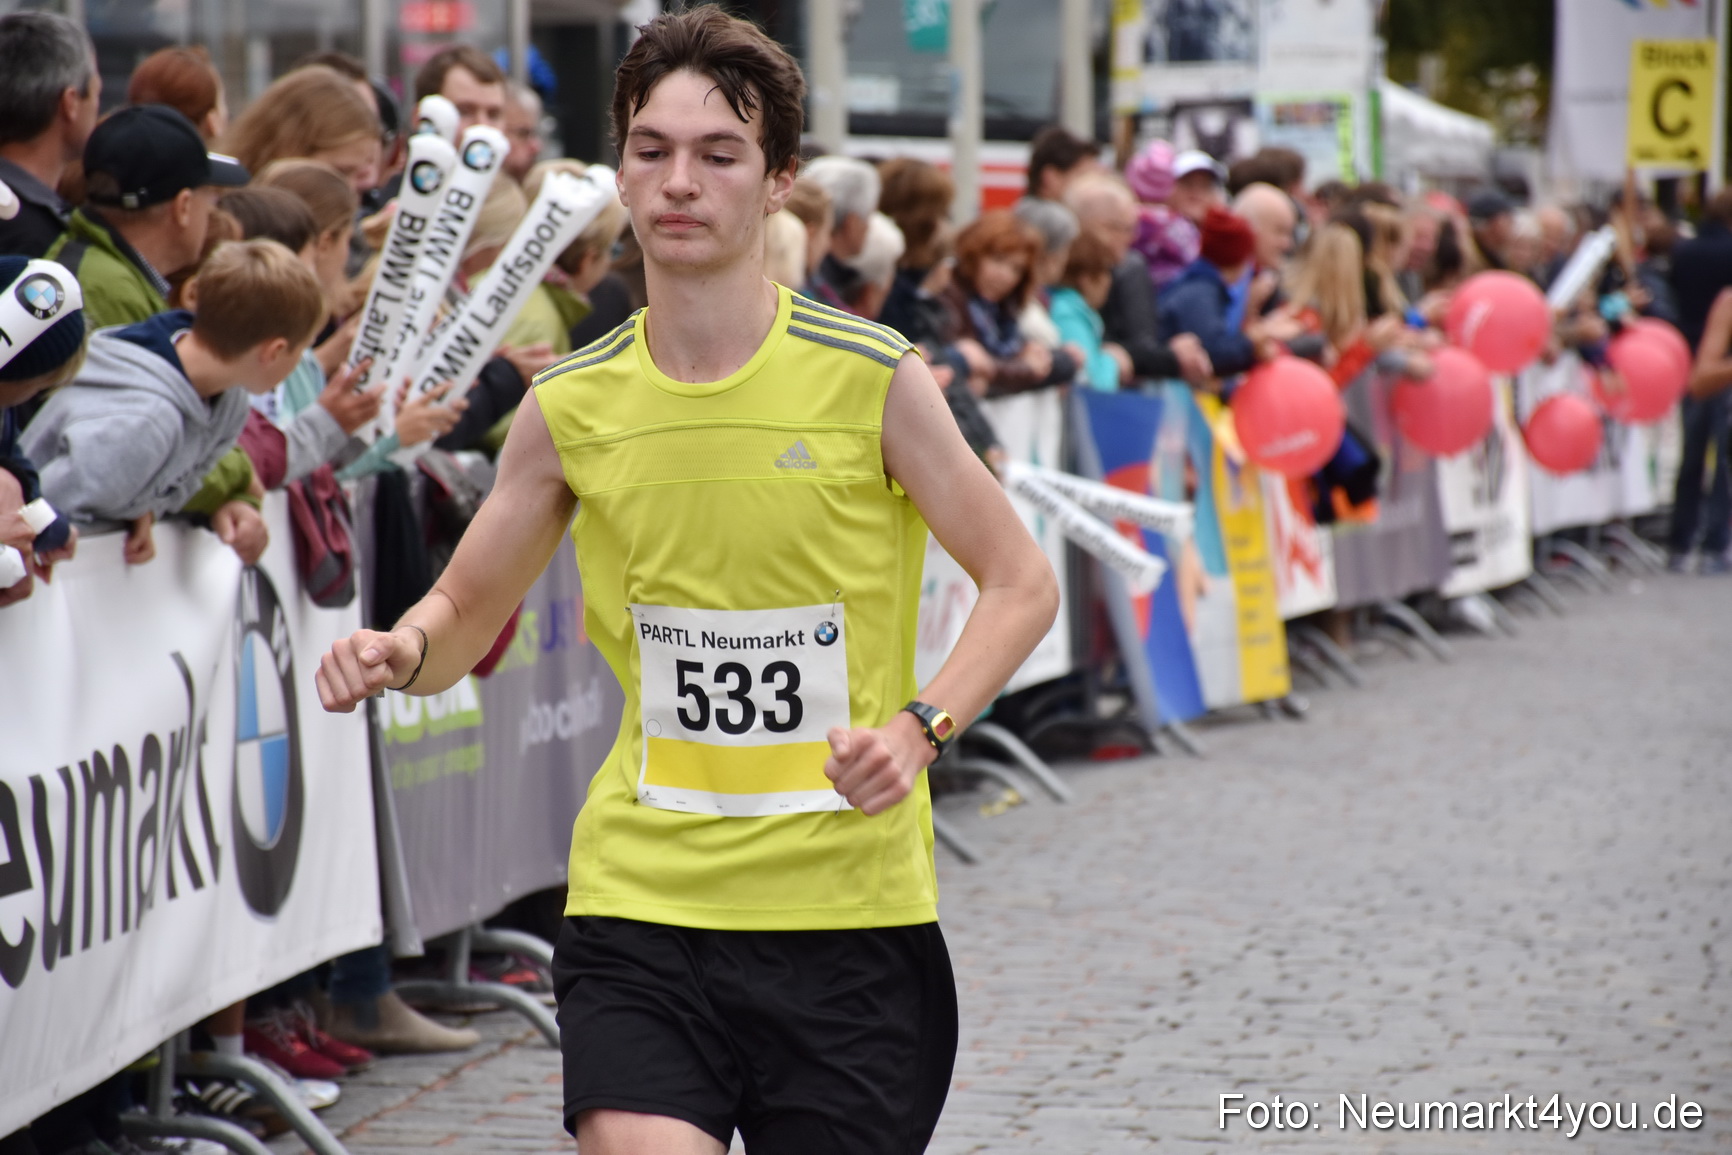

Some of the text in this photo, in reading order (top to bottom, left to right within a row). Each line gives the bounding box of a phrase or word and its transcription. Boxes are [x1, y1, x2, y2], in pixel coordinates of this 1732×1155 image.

[1650, 78, 1694, 139] C
[382, 210, 427, 289] BMW
[469, 199, 572, 331] Laufsport
[774, 458, 817, 470] adidas
[640, 622, 806, 650] PARTL Neumarkt
[675, 658, 804, 735] 533
